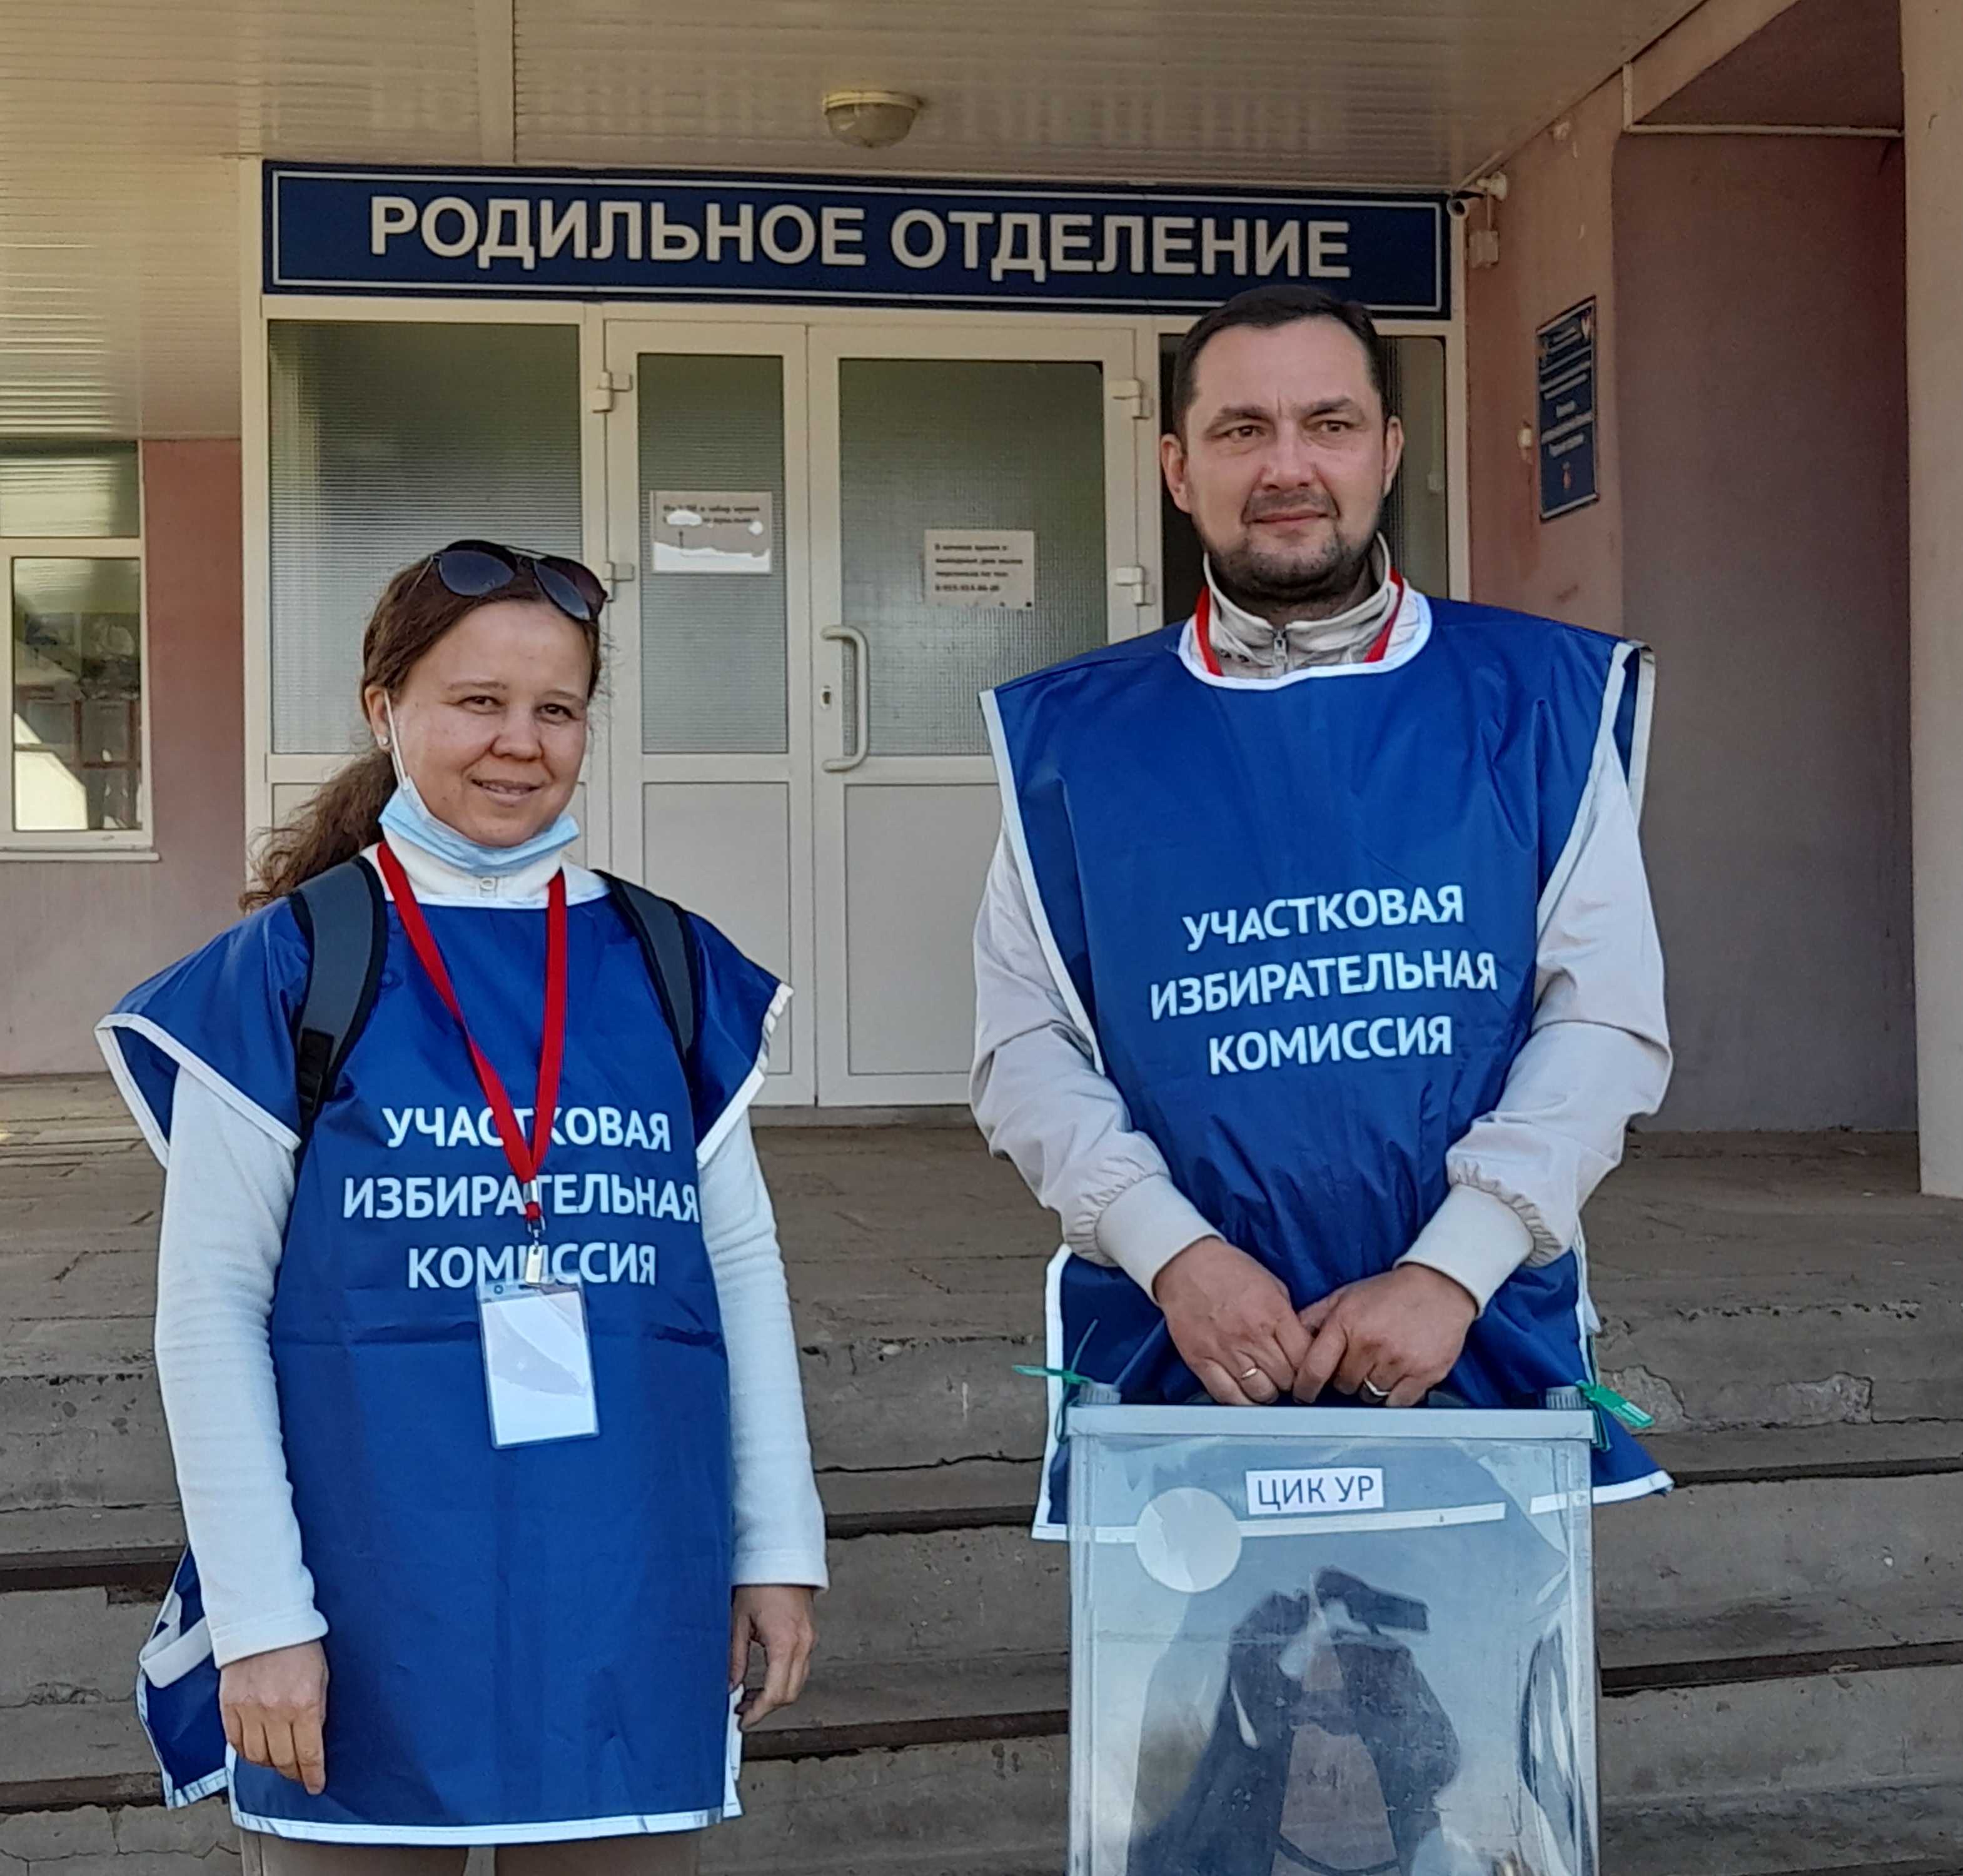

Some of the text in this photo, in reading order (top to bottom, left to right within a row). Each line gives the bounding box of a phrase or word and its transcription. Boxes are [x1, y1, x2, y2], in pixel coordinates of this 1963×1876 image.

[371, 196, 1350, 282] РОДИЛЬНОЕ ОТДЕЛЕНИЕ
[1183, 885, 1464, 952] УЧАСТКОВАЯ
[1151, 950, 1497, 1021] ИЗБИРАТЕЛЬНАЯ
[1209, 1016, 1452, 1076] КОМИССИЯ
[408, 1242, 655, 1289] КОМИССИЯ
[1258, 1475, 1374, 1511] ЦИК УР
